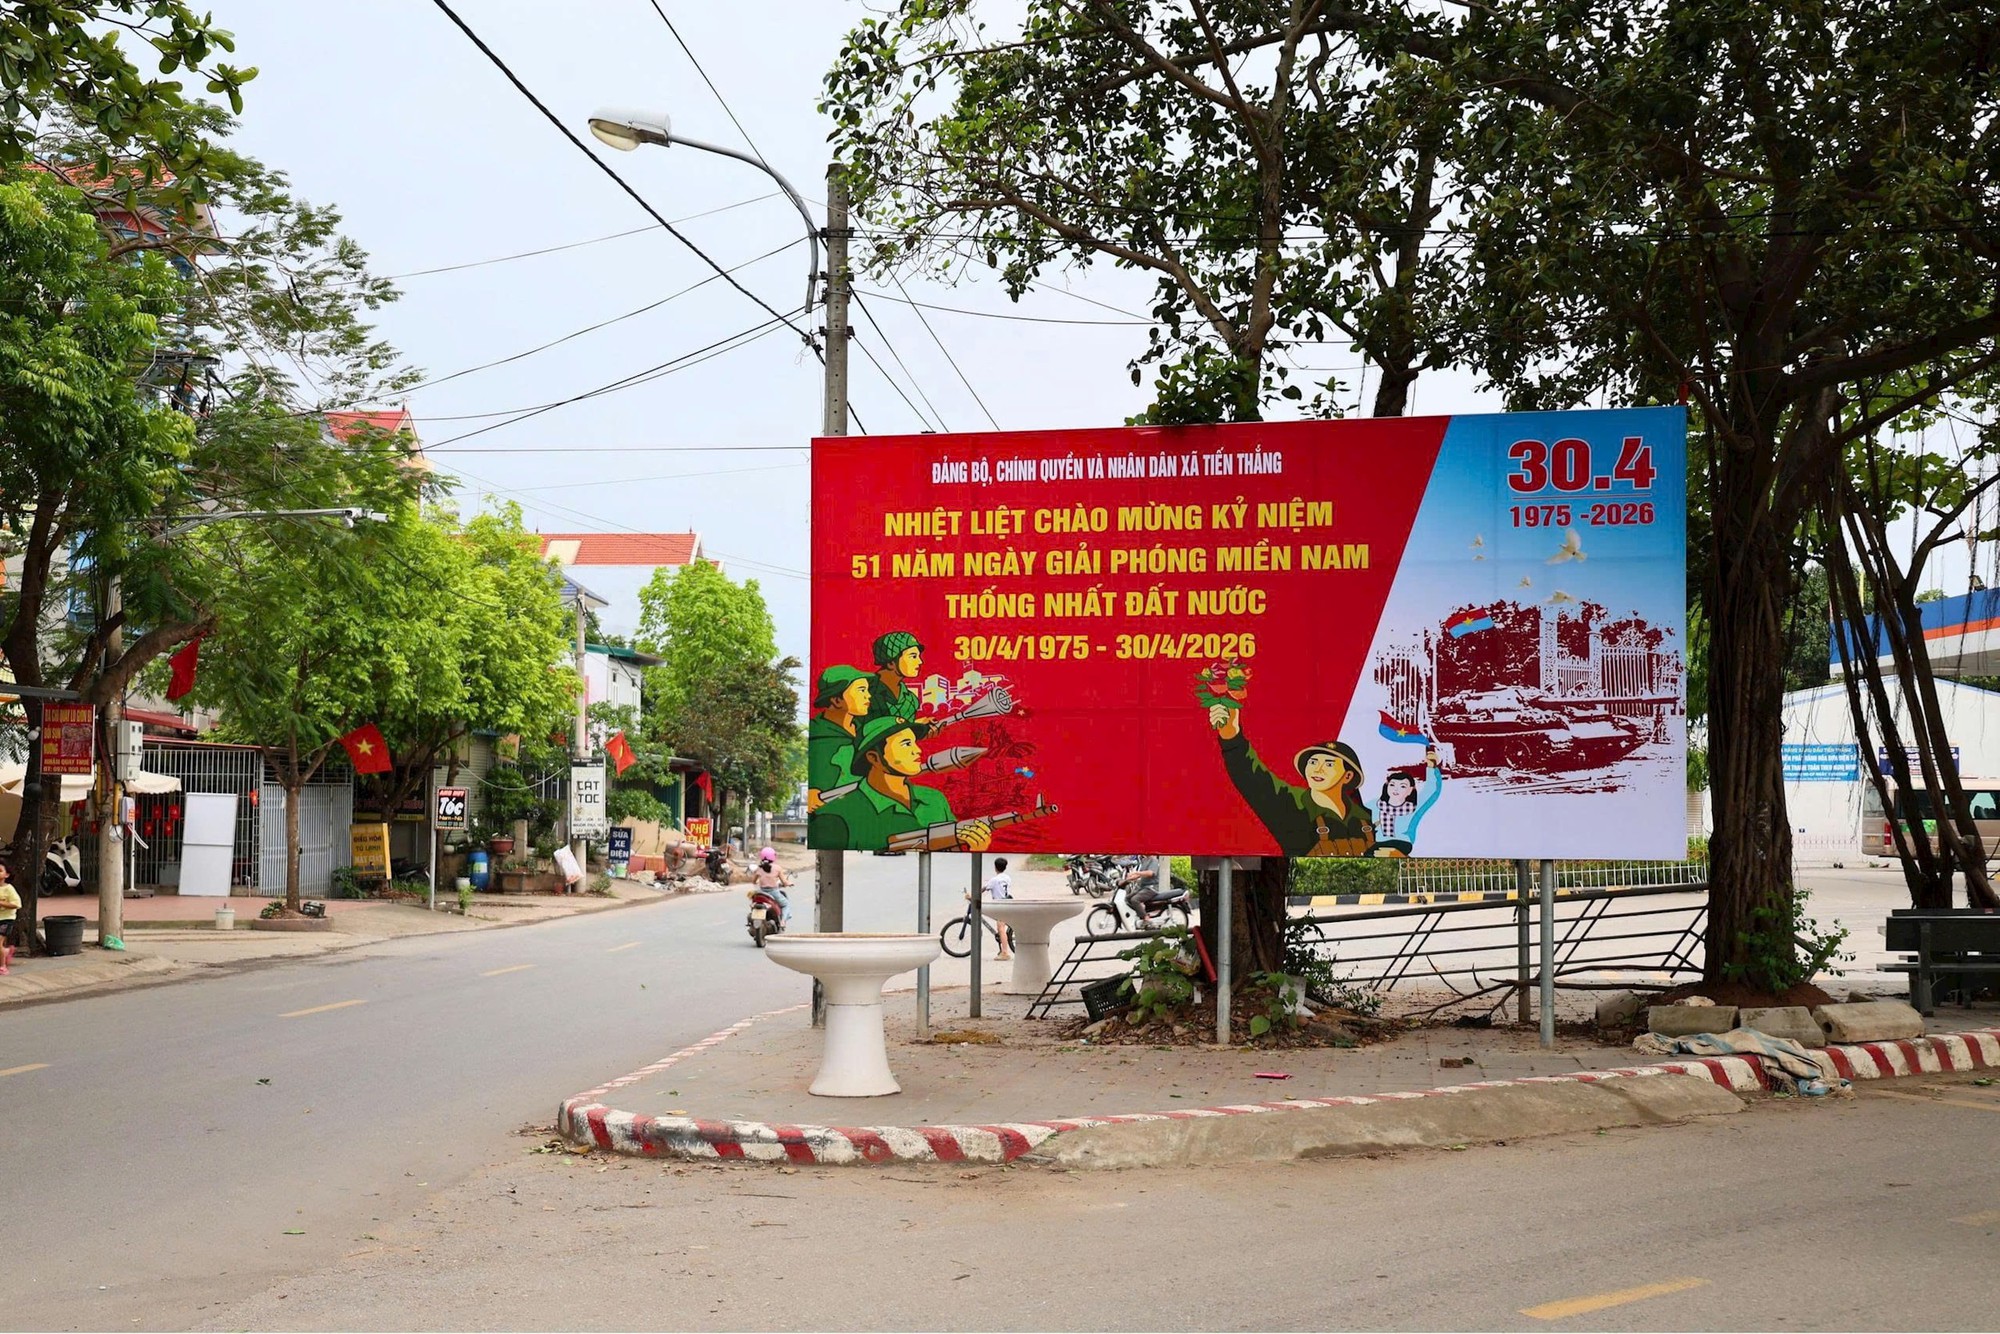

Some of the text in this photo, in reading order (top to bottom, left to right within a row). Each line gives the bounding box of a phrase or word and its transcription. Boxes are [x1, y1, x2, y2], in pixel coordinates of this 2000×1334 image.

[932, 455, 968, 484] ĐẢNG
[971, 457, 993, 487] BỘ,
[996, 455, 1037, 482] CHÍNH
[1087, 452, 1105, 479] VÀ
[1108, 452, 1146, 479] NHÂN
[1149, 451, 1177, 478] DÂN
[1181, 450, 1200, 477] XÃ
[1202, 446, 1233, 476] TIẾN
[1236, 444, 1283, 475] THẮNG
[1507, 436, 1657, 493] 30.4
[884, 495, 1333, 541] NHIỆT LIỆT CHÀO MỪNG KỶ NIỆM
[1510, 502, 1571, 528] 1975
[851, 538, 1370, 579] 51 NĂM NGÀY GIẢI PHÓNG MIỀN NAM
[945, 582, 1267, 619] THỐNG NHẤT ĐẤT NƯỚC
[954, 635, 1090, 661] 30/4/1975
[1115, 632, 1256, 661] 30/4/2026
[612, 828, 629, 839] SỬA
[610, 847, 629, 858] ĐIỆN
